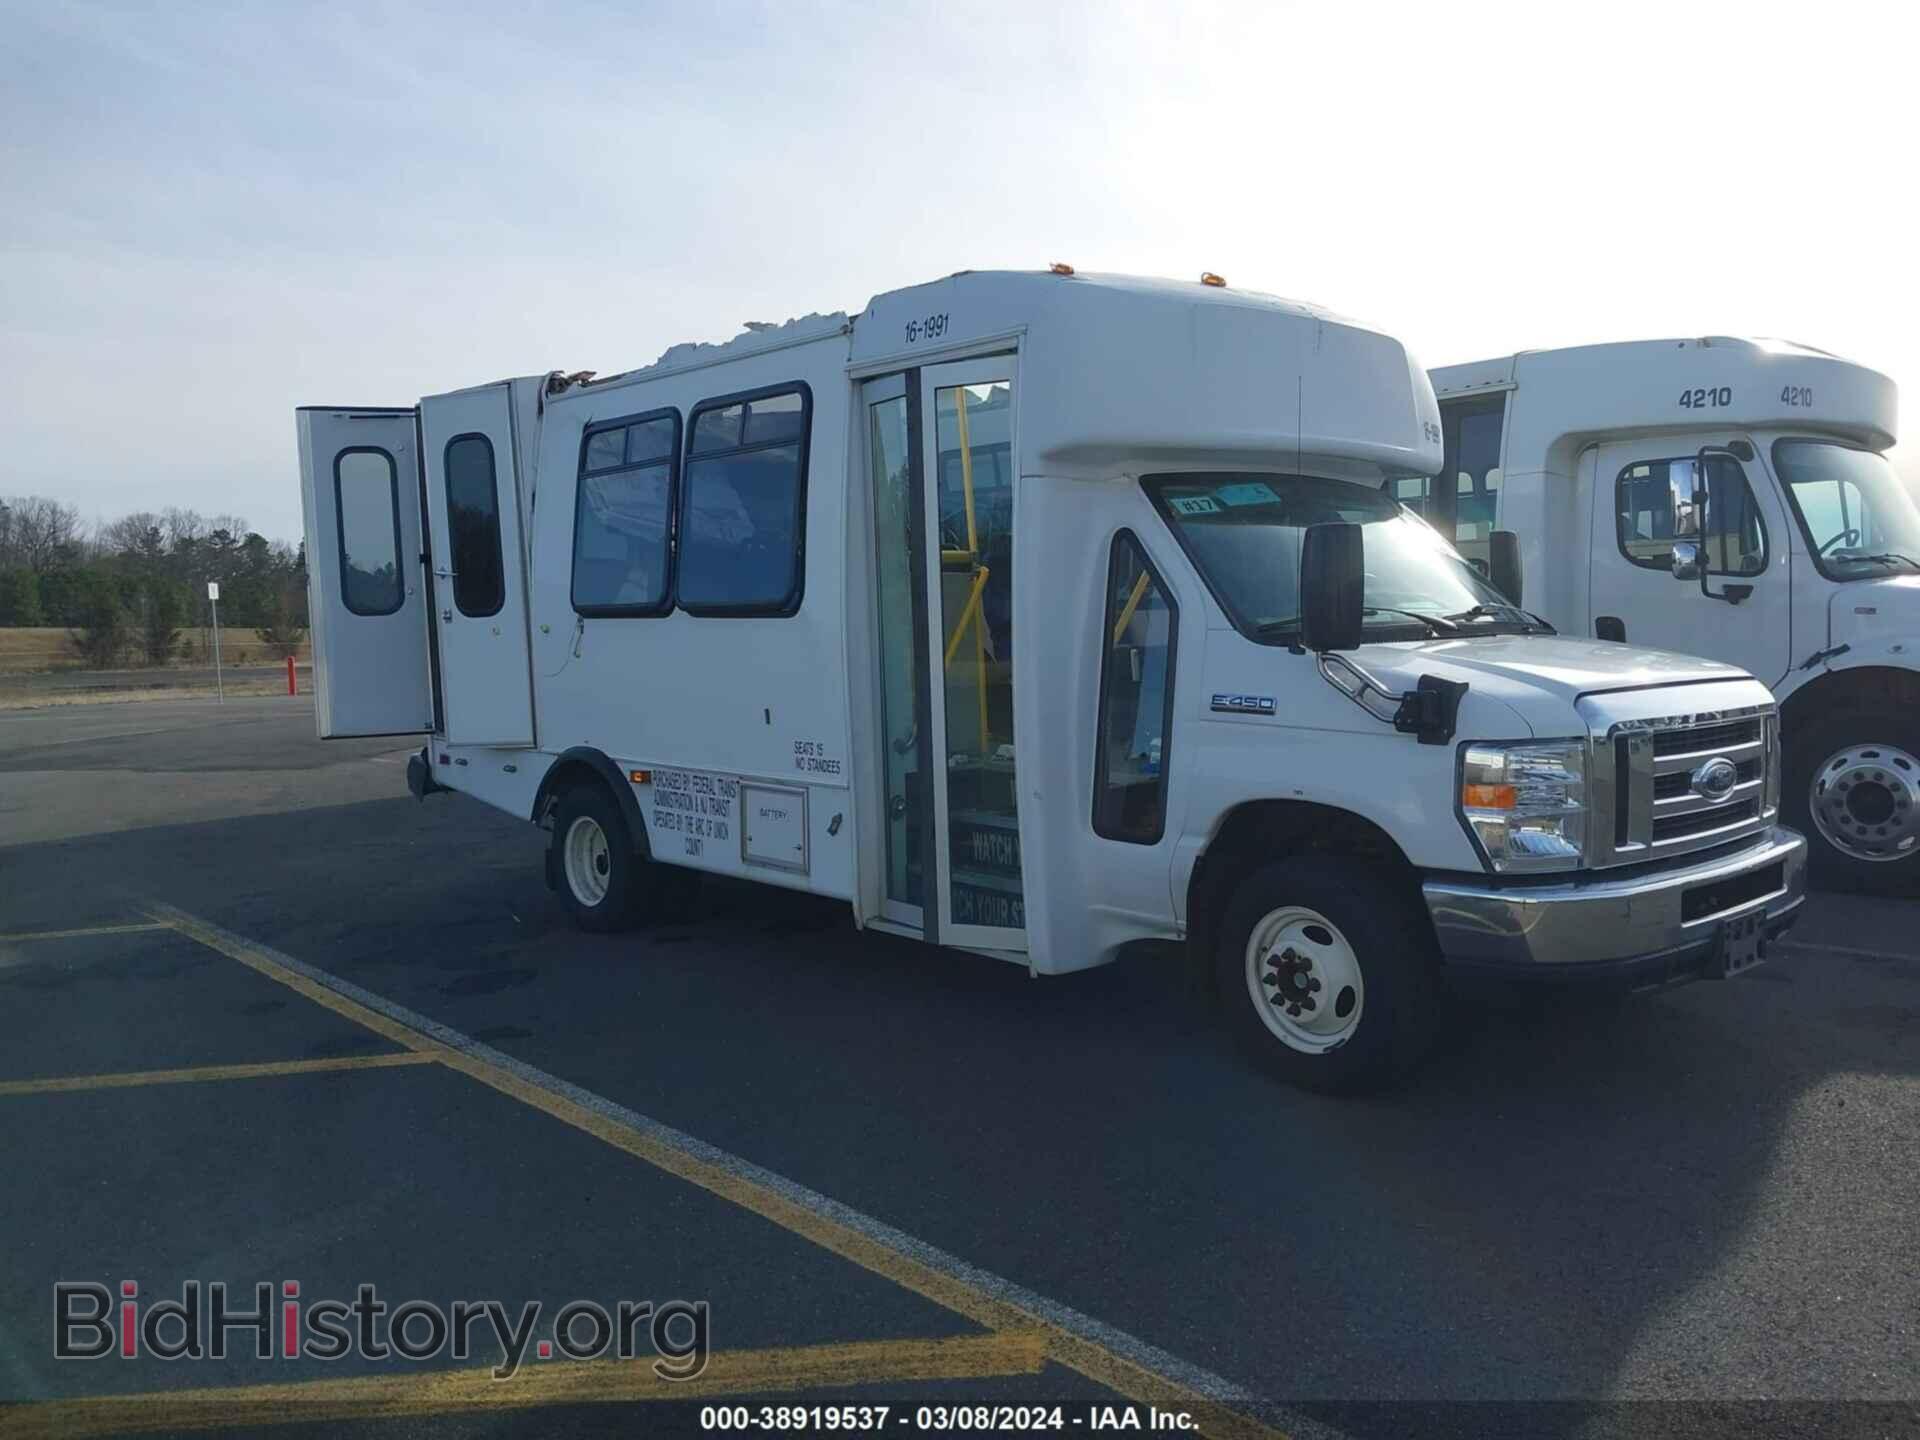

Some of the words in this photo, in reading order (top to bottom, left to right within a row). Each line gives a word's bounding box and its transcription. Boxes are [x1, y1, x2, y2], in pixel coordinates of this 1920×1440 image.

[904, 312, 949, 343] 16-1991
[1679, 387, 1732, 409] 4210
[1781, 385, 1813, 408] 4210
[794, 740, 814, 756] SEATS
[795, 756, 805, 771] NO
[807, 757, 841, 774] STANDEES
[972, 832, 1013, 866] WATCH
